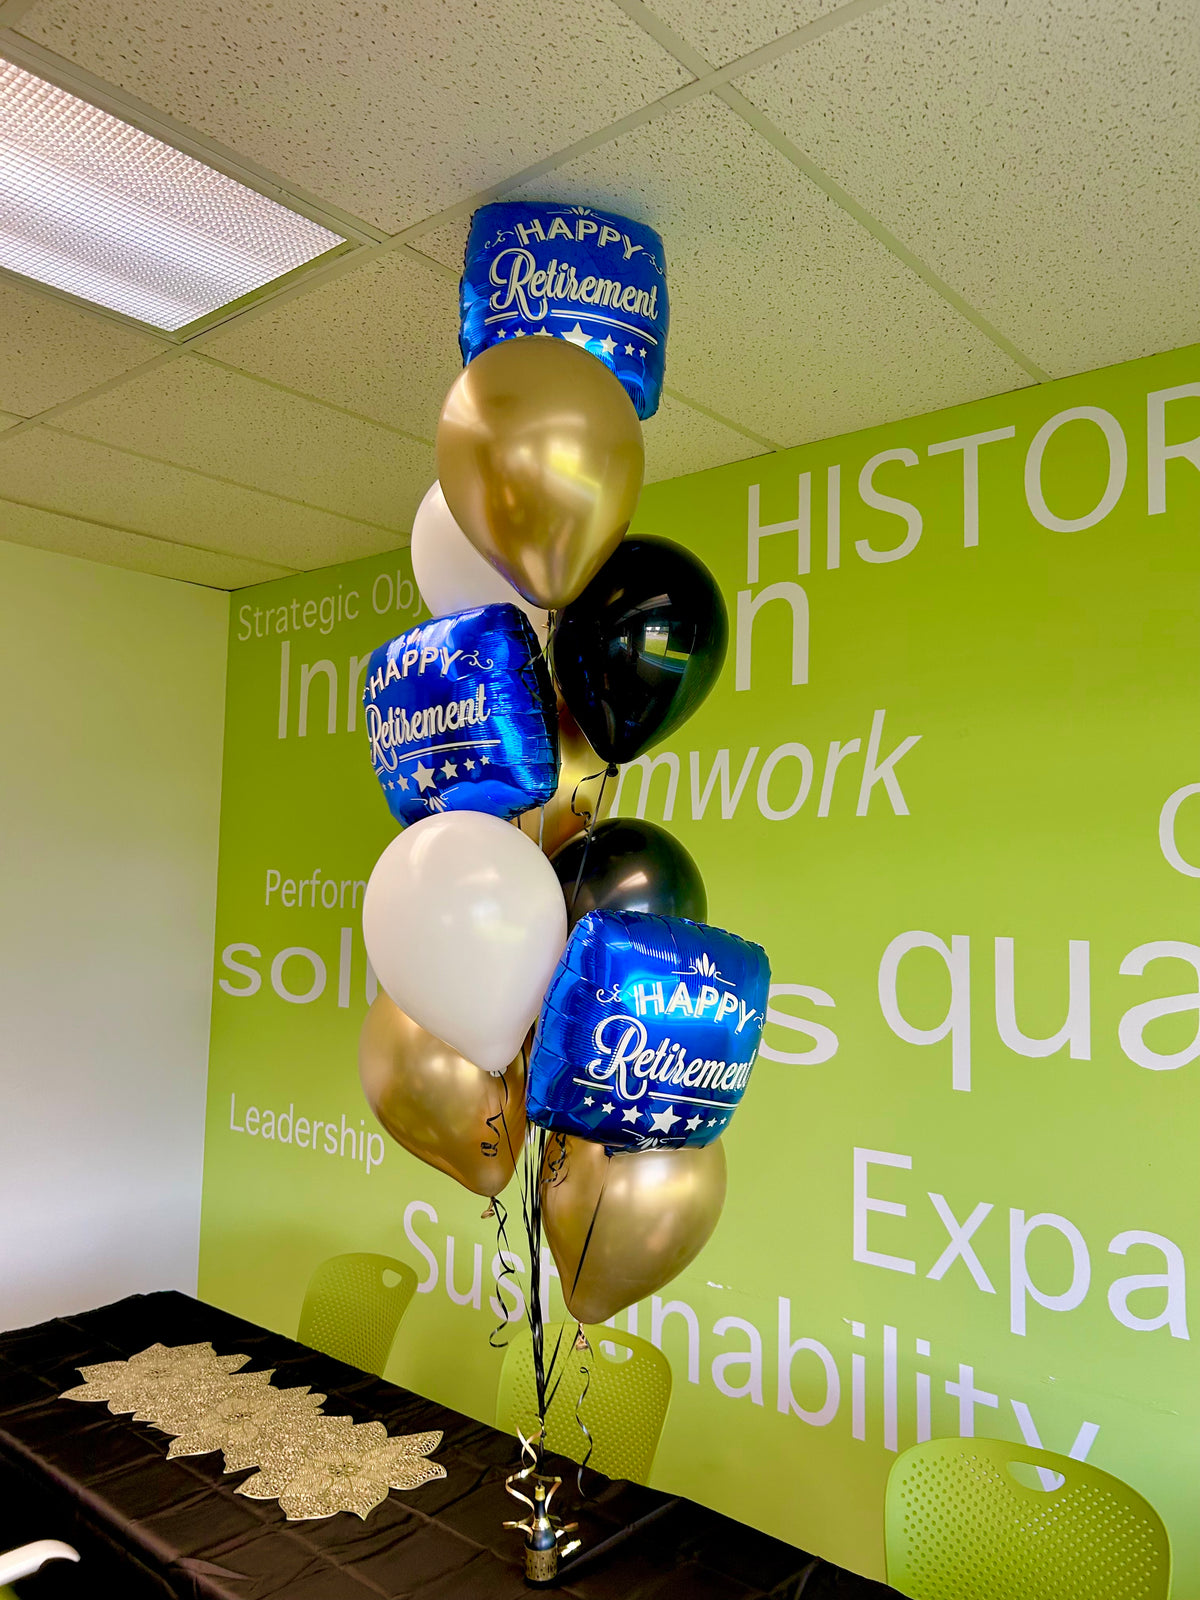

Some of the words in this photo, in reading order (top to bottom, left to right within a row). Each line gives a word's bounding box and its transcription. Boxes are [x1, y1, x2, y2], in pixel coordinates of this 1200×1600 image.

[514, 217, 644, 261] HAPPY
[489, 248, 659, 322] Retirement
[747, 382, 1200, 584] HISTOR
[238, 584, 360, 642] Strategic
[370, 647, 464, 702] HAPPY
[365, 683, 491, 773] Retirement
[633, 981, 757, 1035] HAPPY
[586, 1014, 757, 1100] Retirement
[230, 1092, 385, 1174] Leadership
[853, 1146, 1190, 1340] Expa
[403, 1200, 1100, 1492] Sustnabilit
